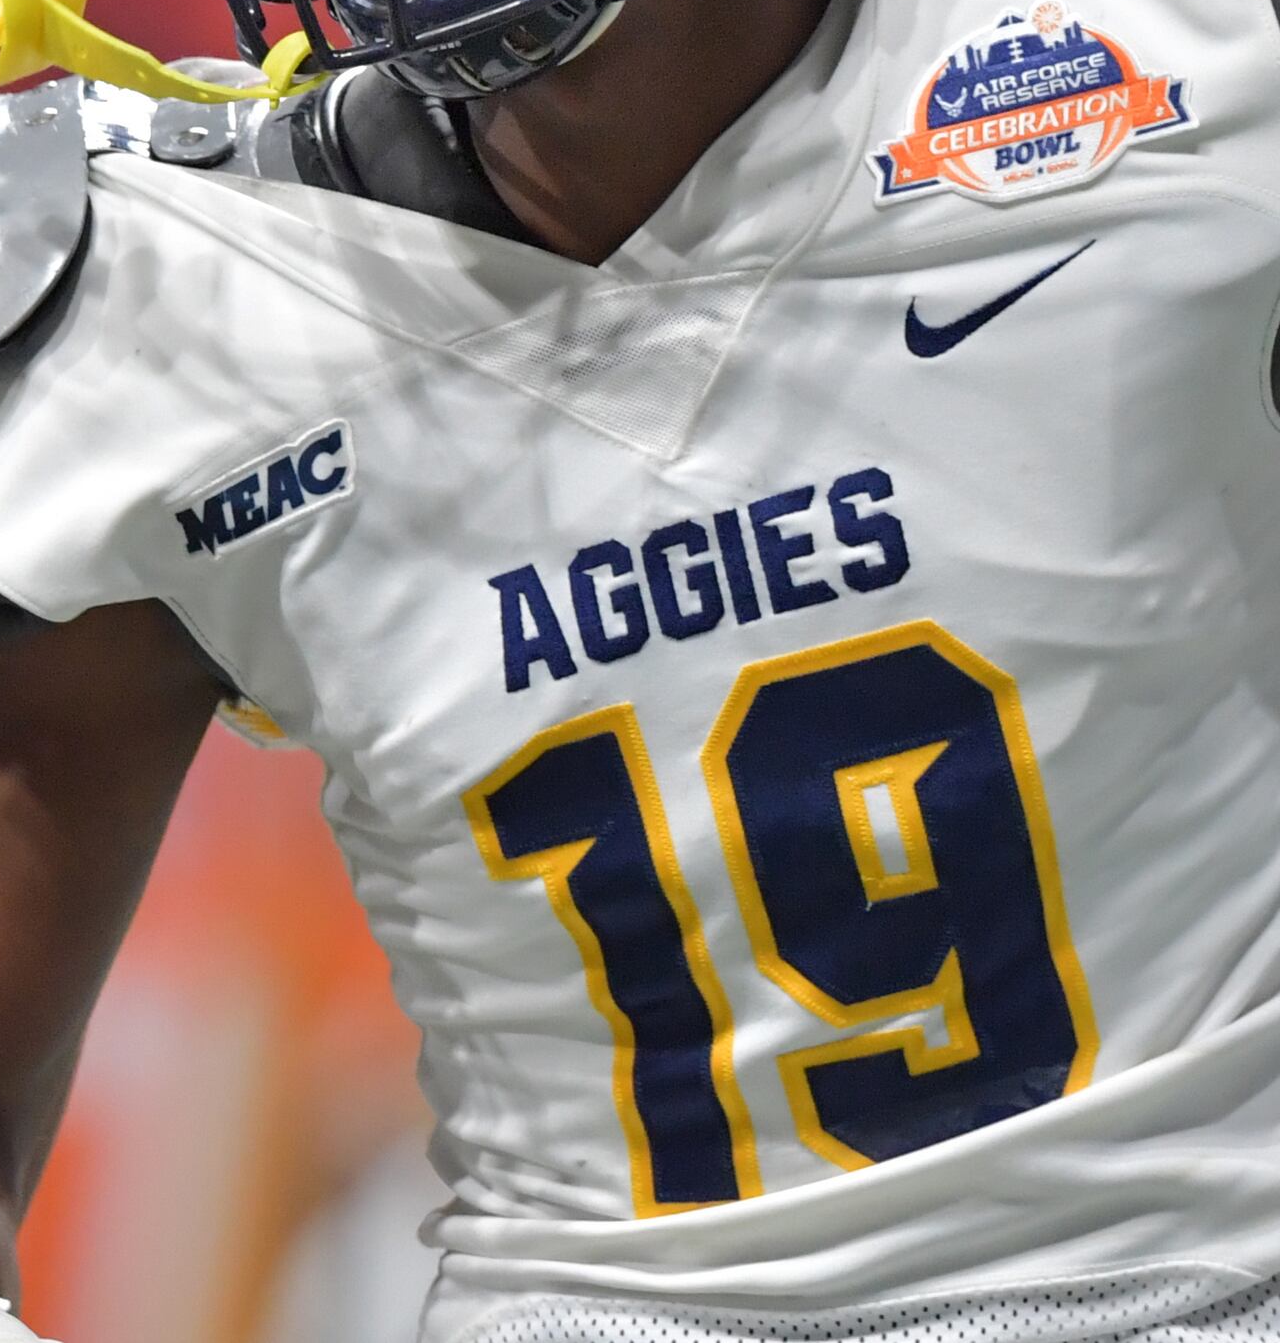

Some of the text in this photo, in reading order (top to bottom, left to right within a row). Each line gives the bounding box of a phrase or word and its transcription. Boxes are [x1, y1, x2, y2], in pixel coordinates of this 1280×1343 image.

[972, 52, 1107, 98] AIR FORCE
[980, 68, 1102, 111] RESERVE
[928, 88, 1130, 156] CELEBRATION
[994, 130, 1081, 171] BOWL
[175, 428, 347, 555] MEAC
[488, 466, 910, 693] AGGIES
[462, 618, 1101, 1219] 19
